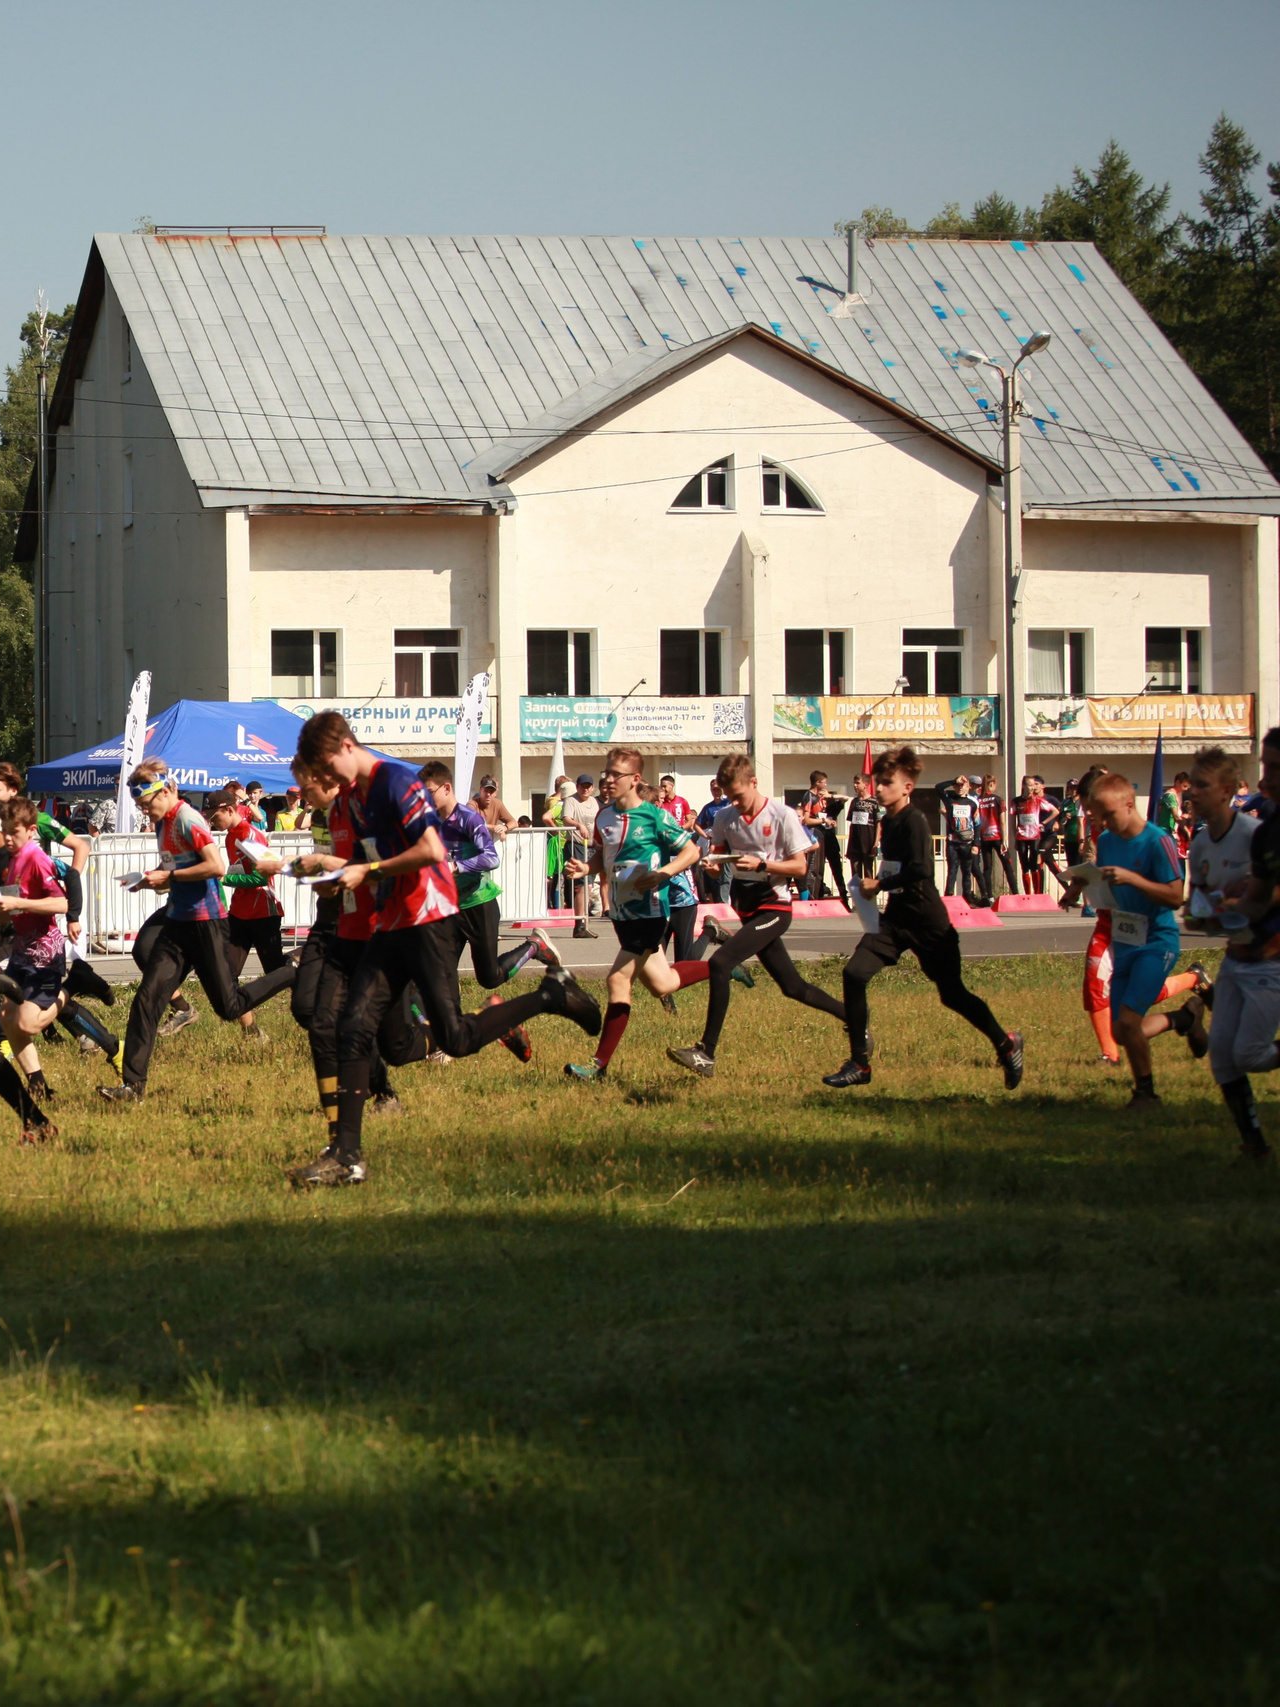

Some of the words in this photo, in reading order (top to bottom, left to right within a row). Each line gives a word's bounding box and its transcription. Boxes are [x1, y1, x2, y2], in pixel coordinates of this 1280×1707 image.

[524, 701, 570, 713] Запись
[584, 705, 614, 714] группы
[626, 704, 689, 713] кунгфу-малыш
[836, 703, 896, 716] ПРОКАТ
[900, 703, 940, 716] ЛЫЖ
[1095, 703, 1246, 721] ТЮБИНГ-ПРОКАТ
[525, 716, 580, 729] круглый
[582, 716, 608, 729] год!
[626, 714, 673, 722] школьники
[674, 713, 690, 721] 7-17
[626, 724, 666, 732] взрослые
[668, 723, 683, 731] 40+
[829, 719, 840, 731] И
